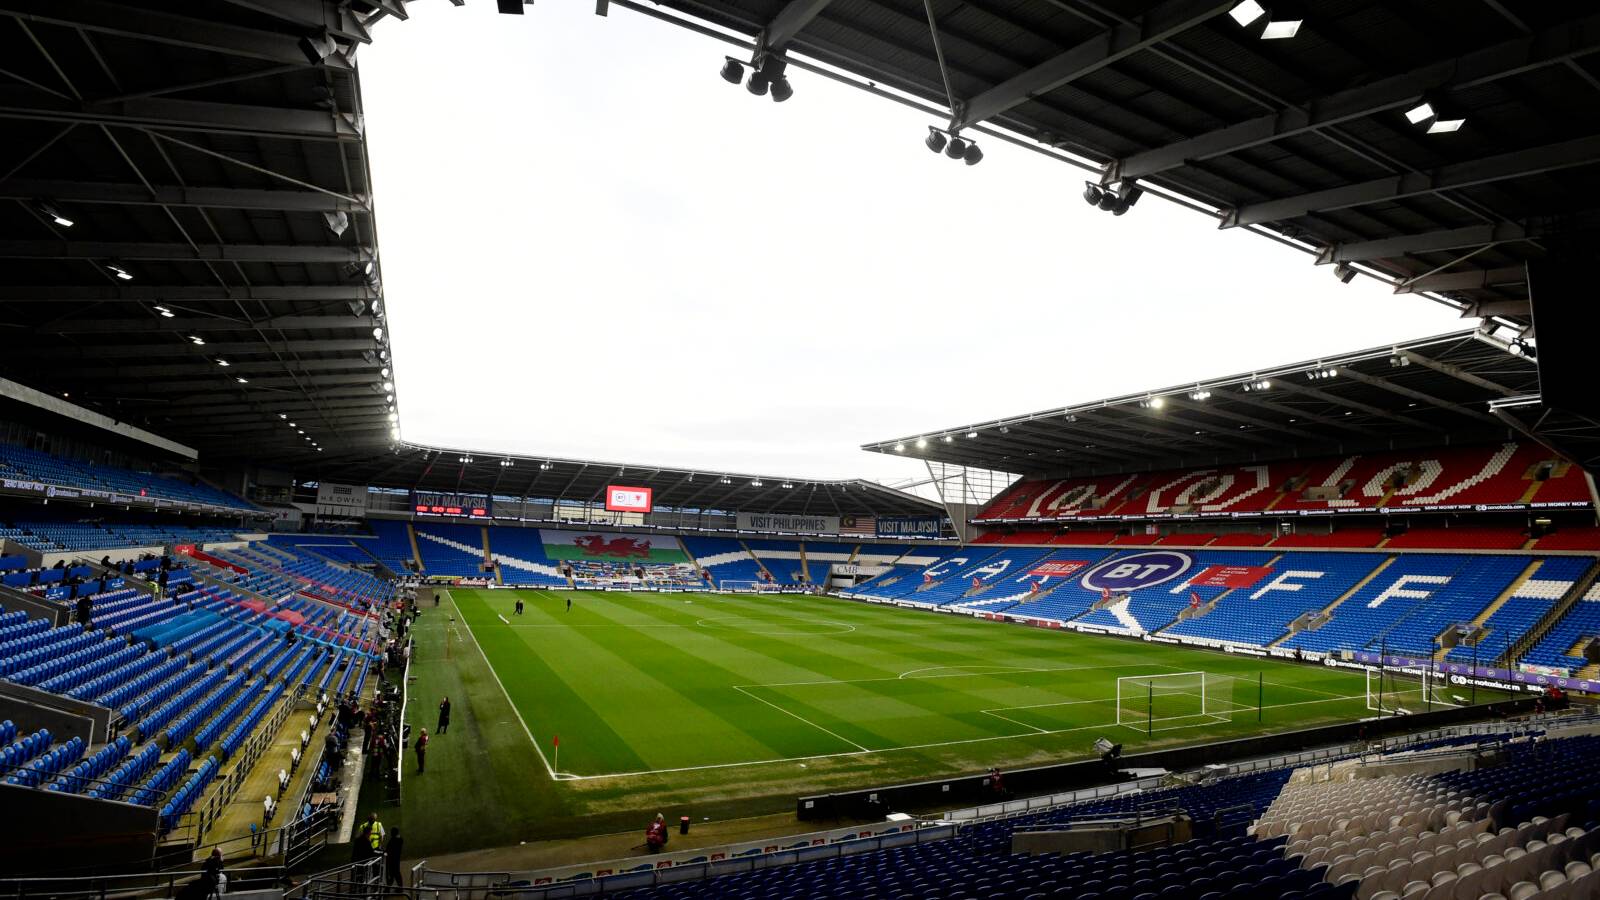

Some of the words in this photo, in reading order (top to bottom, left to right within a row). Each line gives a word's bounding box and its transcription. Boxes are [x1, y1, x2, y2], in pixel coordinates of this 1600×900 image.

[417, 494, 439, 506] VISIT
[442, 496, 487, 509] MALAYSIA
[750, 516, 771, 528] VISIT
[773, 517, 826, 531] PHILIPPINES
[878, 520, 899, 533] VISIT
[900, 520, 938, 533] MALAYSIA
[837, 565, 858, 574] CMB
[1102, 563, 1172, 580] BT
